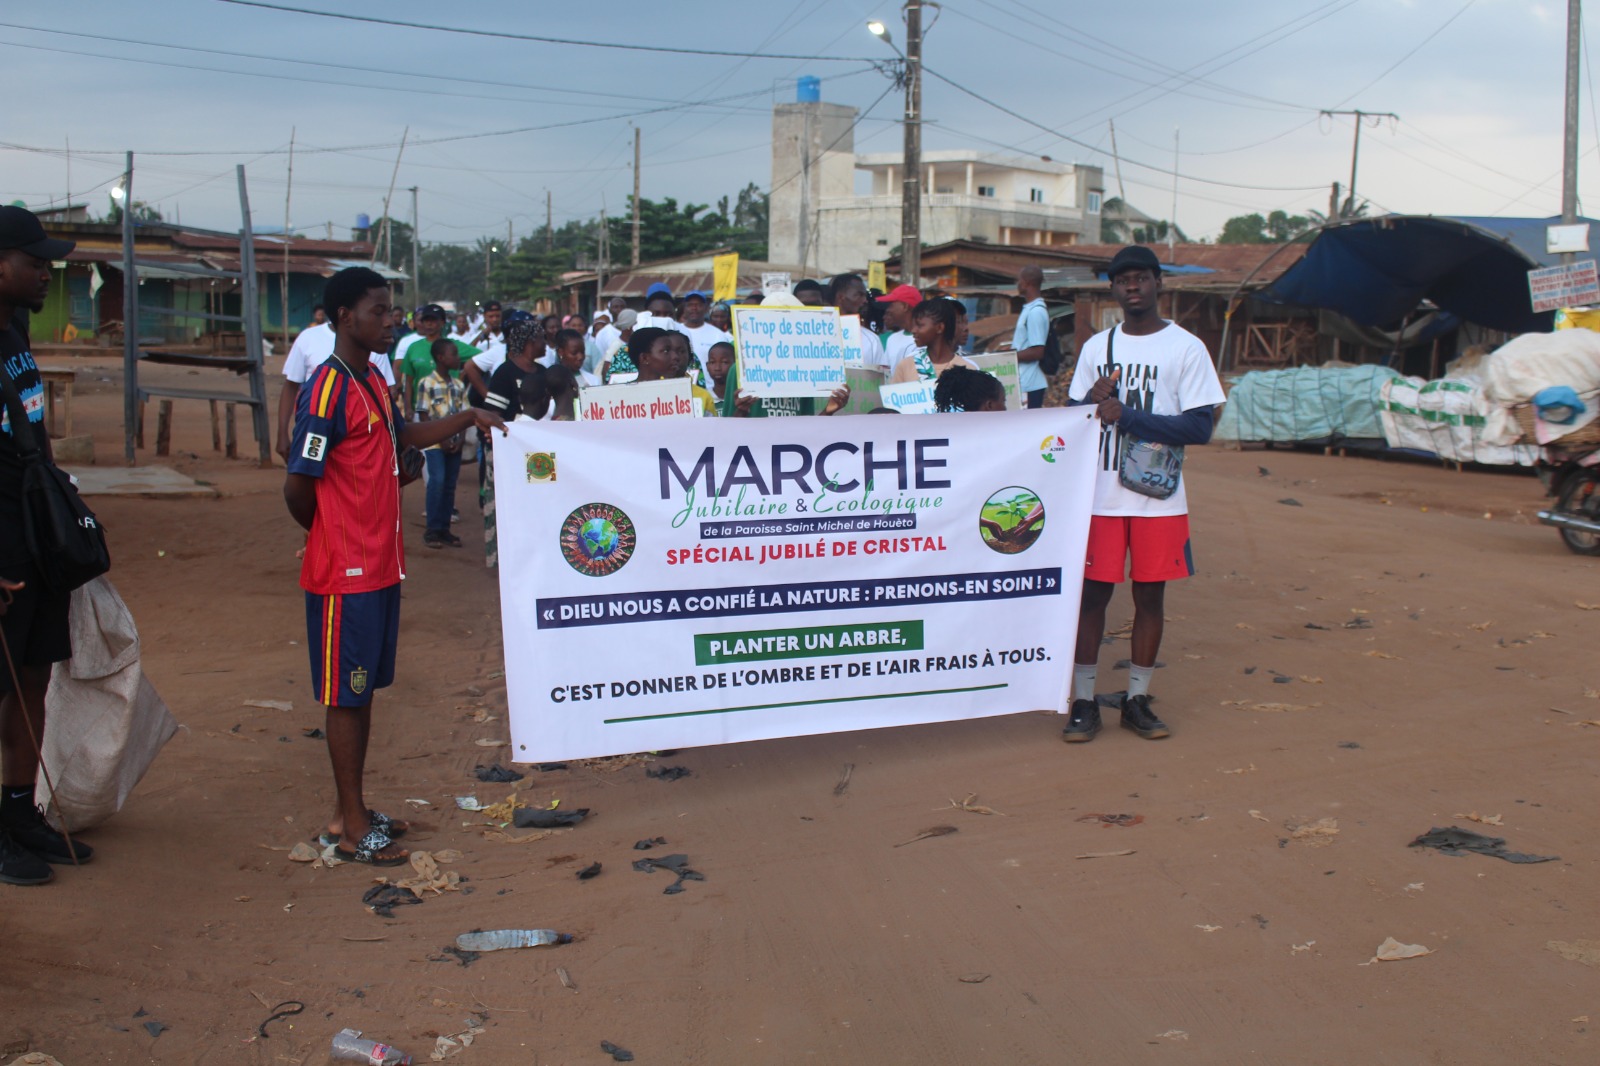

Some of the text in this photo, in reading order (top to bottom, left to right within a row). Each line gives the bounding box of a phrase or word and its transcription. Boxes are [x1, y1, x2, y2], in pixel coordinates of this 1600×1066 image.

[780, 318, 793, 335] de
[745, 340, 773, 363] trop
[776, 341, 790, 359] de
[745, 365, 786, 387] nettoyons
[787, 365, 809, 382] notre
[651, 396, 674, 419] plus
[676, 395, 692, 413] les
[659, 438, 951, 499] MARCHE
[672, 472, 943, 528] Jubilaire & Écologique
[703, 518, 914, 537] de la Paroisse Saint Michel de Houèto
[666, 536, 947, 565] SPÉCIAL JUBILÉ DE CRISTAL
[543, 609, 555, 621] «
[560, 602, 604, 621] DIEU
[608, 598, 663, 617] NOUS
[667, 597, 682, 613] A
[685, 588, 756, 612] CONFIÉ
[760, 591, 784, 607] LA
[787, 587, 861, 606] NATURE
[874, 579, 988, 600] PRENONS-EN
[992, 576, 1033, 592] SOIN
[710, 628, 907, 657] PLANTER UN ARBRE,
[550, 647, 1051, 704] C'EST DONNER DE L'OMBRE ET DE L'AIR FRAIS À TOUS.
